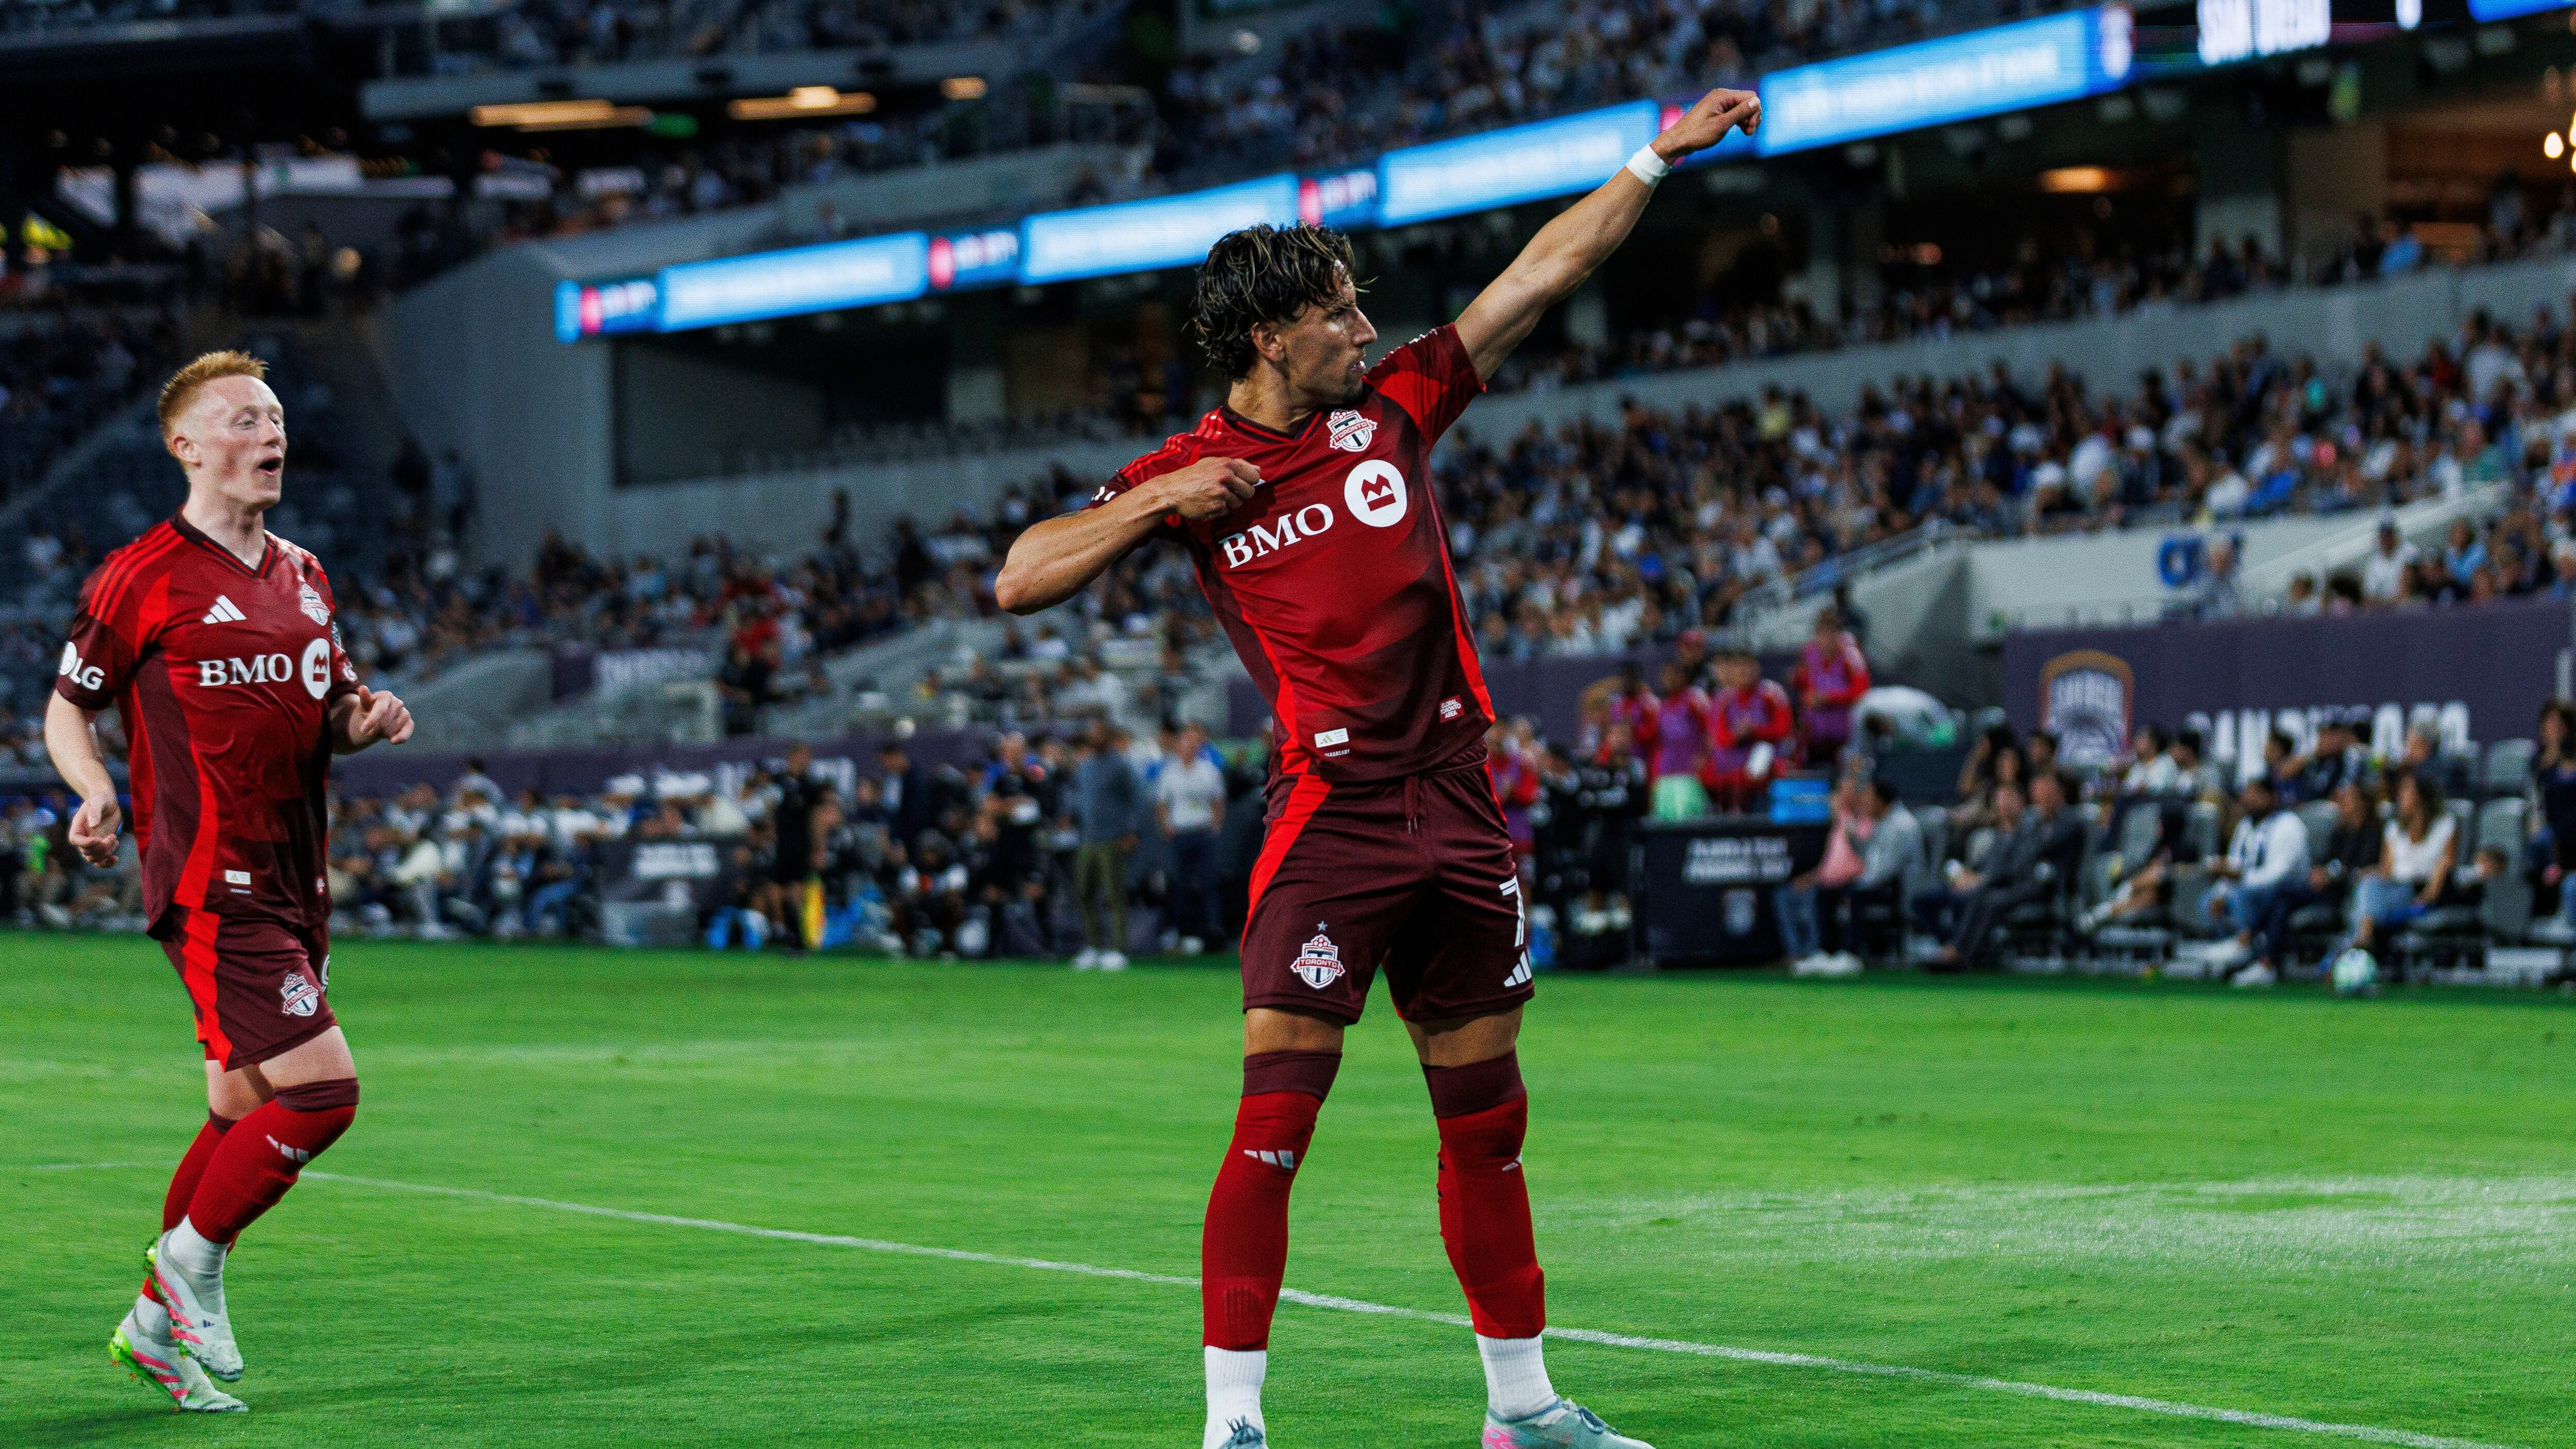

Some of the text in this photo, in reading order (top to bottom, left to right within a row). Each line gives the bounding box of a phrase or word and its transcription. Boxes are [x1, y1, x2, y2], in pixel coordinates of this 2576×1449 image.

[1333, 421, 1367, 441] TORONTO
[1218, 503, 1334, 568] BMO
[70, 657, 105, 690] LG
[198, 653, 293, 687] BMO
[1499, 875, 1526, 947] 7
[1300, 958, 1337, 968] TORONTO
[287, 988, 313, 1006] TORONTO
